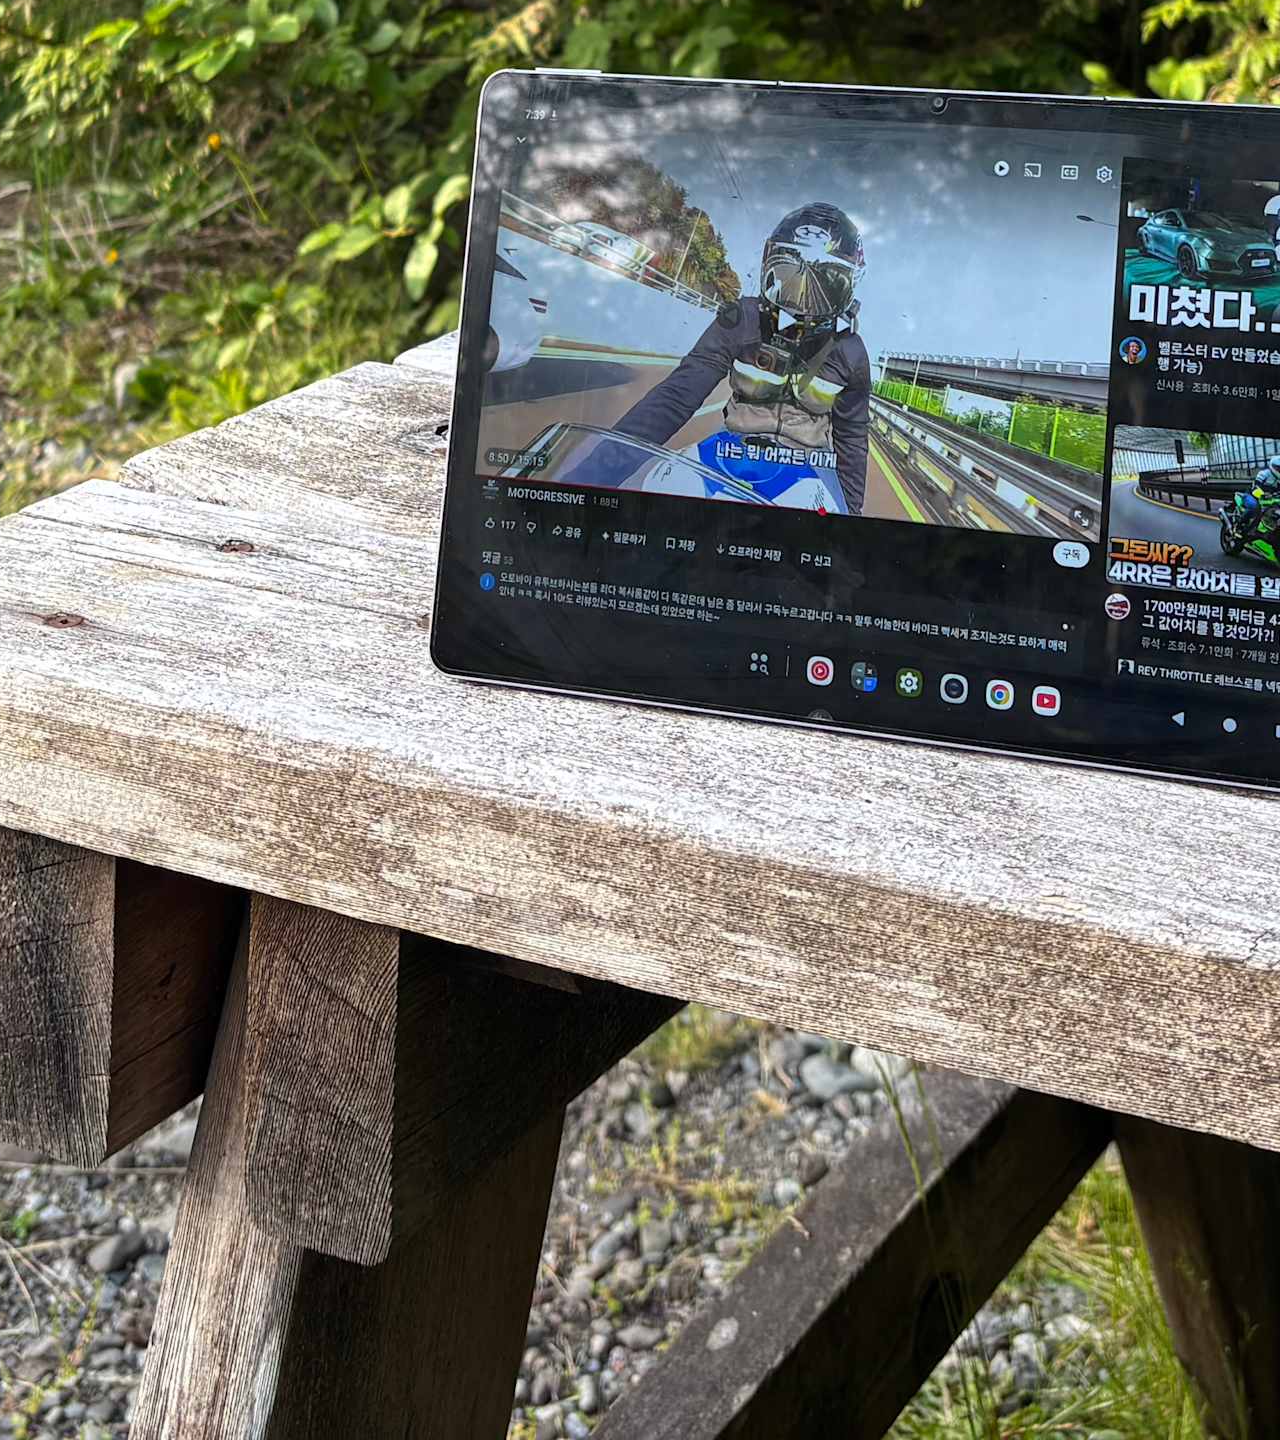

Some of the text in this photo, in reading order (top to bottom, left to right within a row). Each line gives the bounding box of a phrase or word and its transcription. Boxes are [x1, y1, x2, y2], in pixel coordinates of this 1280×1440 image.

[525, 109, 545, 120] 7:39
[1158, 341, 1208, 359] 벨로스터
[1211, 346, 1229, 360] EV
[1157, 357, 1203, 375] 행 가능)
[1156, 379, 1184, 392] 신사용
[1191, 382, 1220, 395] 조회수
[1222, 385, 1258, 399] 3.6만회
[1266, 389, 1280, 401] 1일
[716, 441, 838, 468] 나는 뭐 어쨌든 이게
[507, 487, 586, 505] MOTOGRESSIVE
[501, 520, 516, 530] 117
[677, 539, 696, 552] 저장
[728, 545, 762, 560] 오프라인
[763, 549, 782, 562] 저장
[814, 555, 832, 567] 신고
[482, 551, 501, 565] 댓글
[1108, 561, 1172, 587] 4RR은
[1176, 567, 1256, 597] 값어치를
[1143, 599, 1224, 621] 1700만원짜리
[1227, 608, 1266, 626] 쿼터급
[912, 622, 939, 636] 바이크
[970, 629, 1016, 646] 조지는것도
[1018, 635, 1047, 650] 묘하게
[1048, 639, 1067, 653] 매력
[1141, 614, 1155, 628] 그
[1158, 616, 1209, 636] 값어치를
[1212, 622, 1274, 643] 할것인가?!
[1167, 640, 1197, 654] 조회수
[1240, 649, 1267, 663] 7개월
[1269, 652, 1280, 665] 전
[1138, 665, 1158, 677] REV
[1159, 667, 1212, 684] THROTTLE
